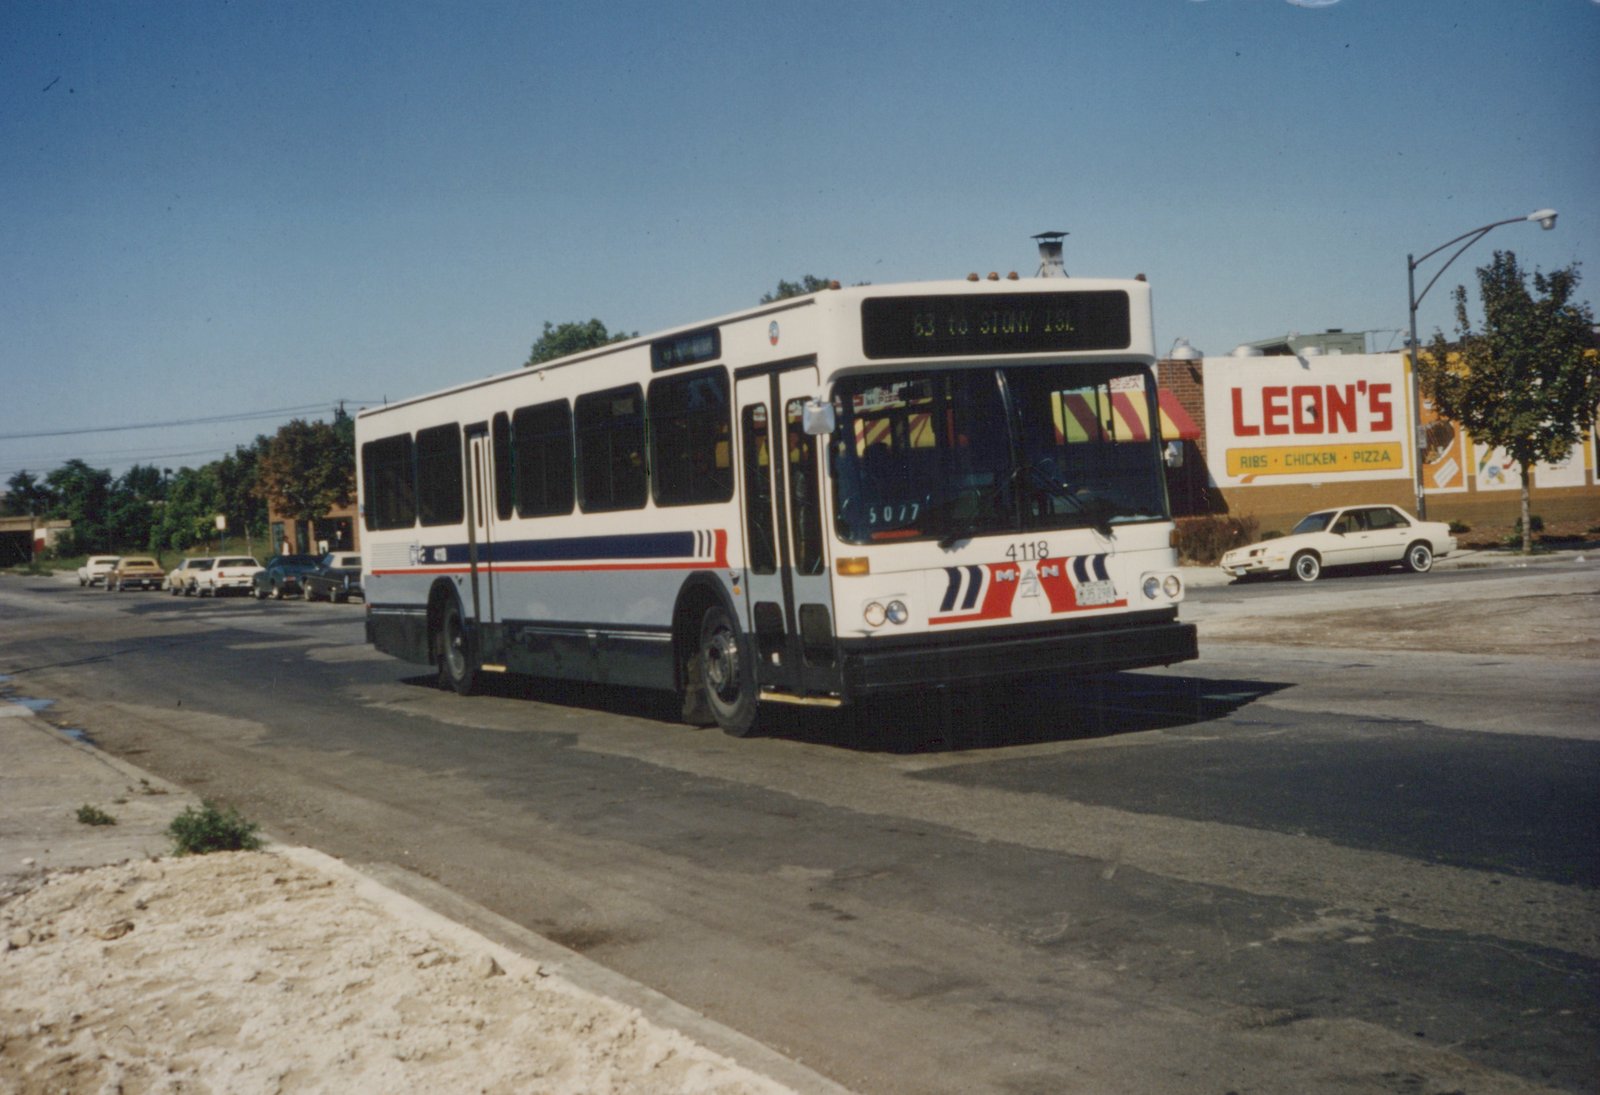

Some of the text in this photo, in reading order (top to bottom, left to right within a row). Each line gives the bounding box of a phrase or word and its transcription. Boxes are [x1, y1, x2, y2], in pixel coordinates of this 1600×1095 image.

[1230, 380, 1393, 437] LEON'S
[1240, 448, 1392, 470] RIBS CHICKEN PIZZA
[1005, 541, 1049, 563] 4118
